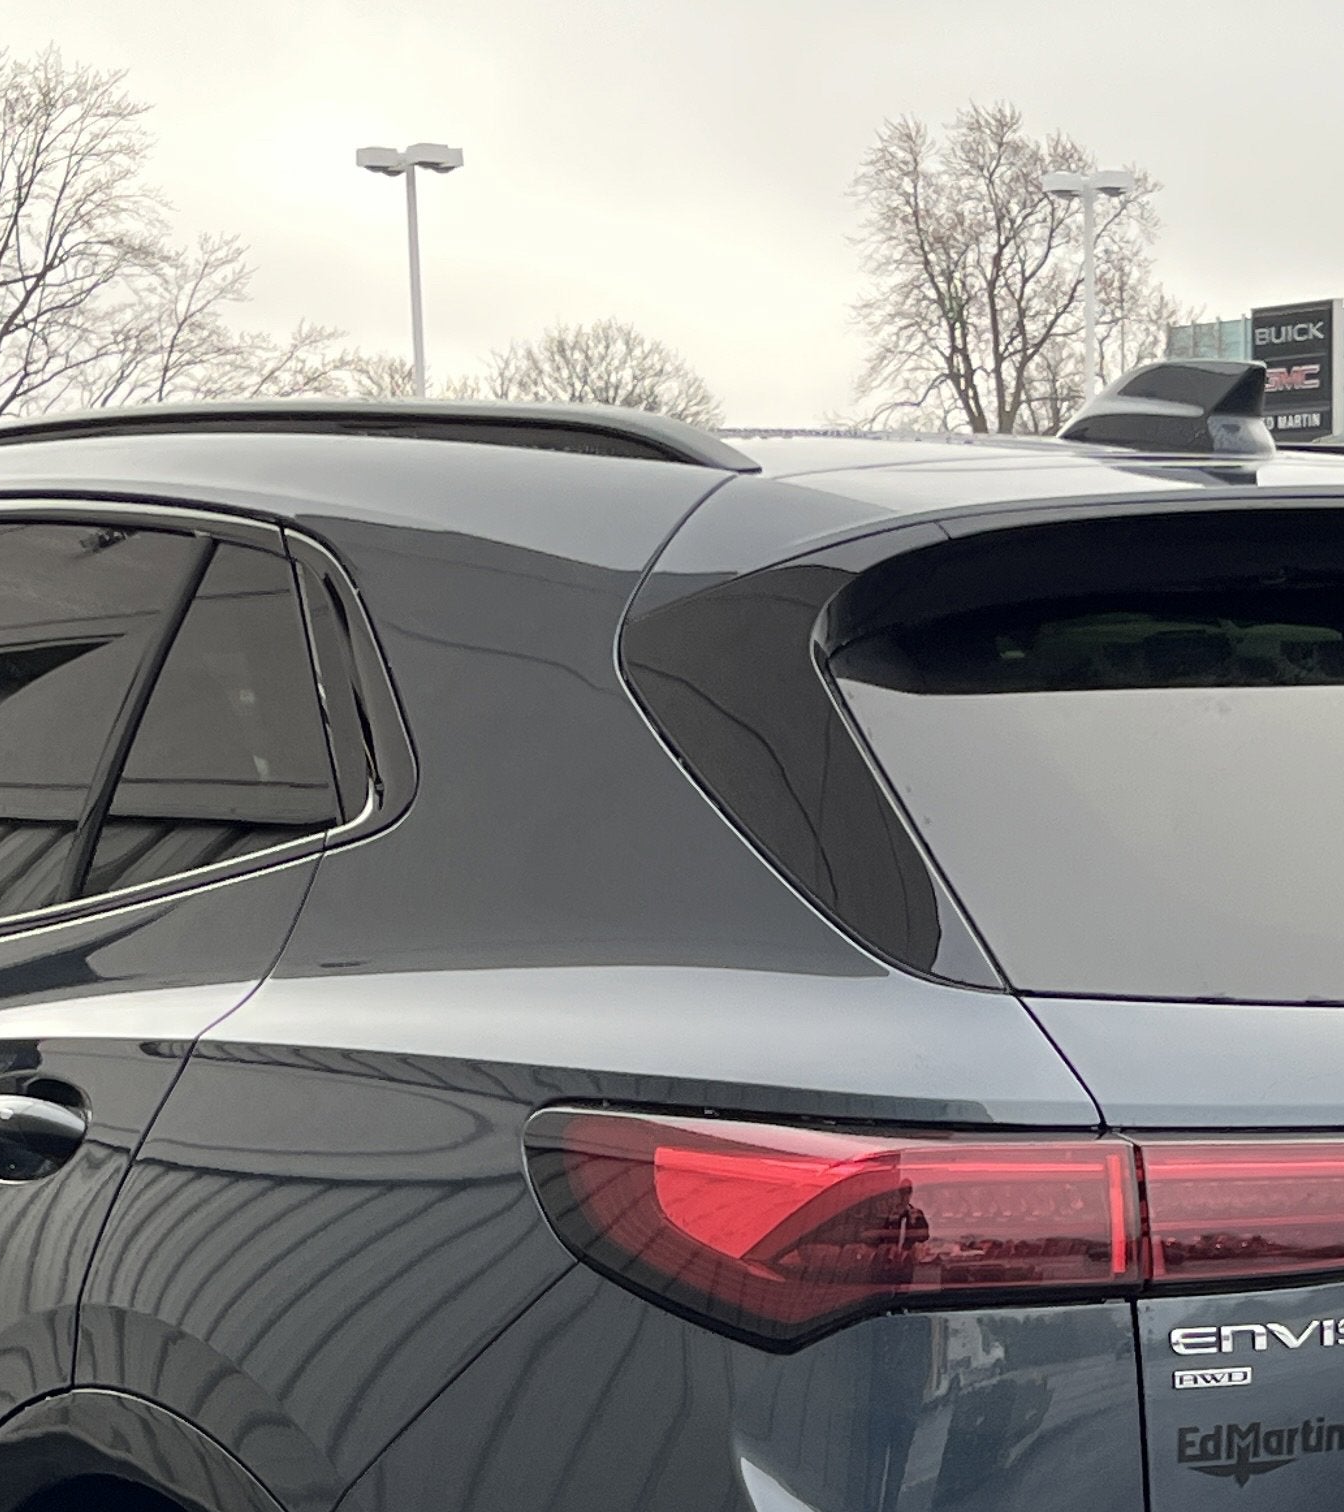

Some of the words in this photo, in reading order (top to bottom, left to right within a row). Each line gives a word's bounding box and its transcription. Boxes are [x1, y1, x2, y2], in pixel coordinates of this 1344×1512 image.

[1254, 322, 1324, 346] BUICK
[1277, 412, 1321, 430] MARTIN
[1176, 1368, 1250, 1387] AWD
